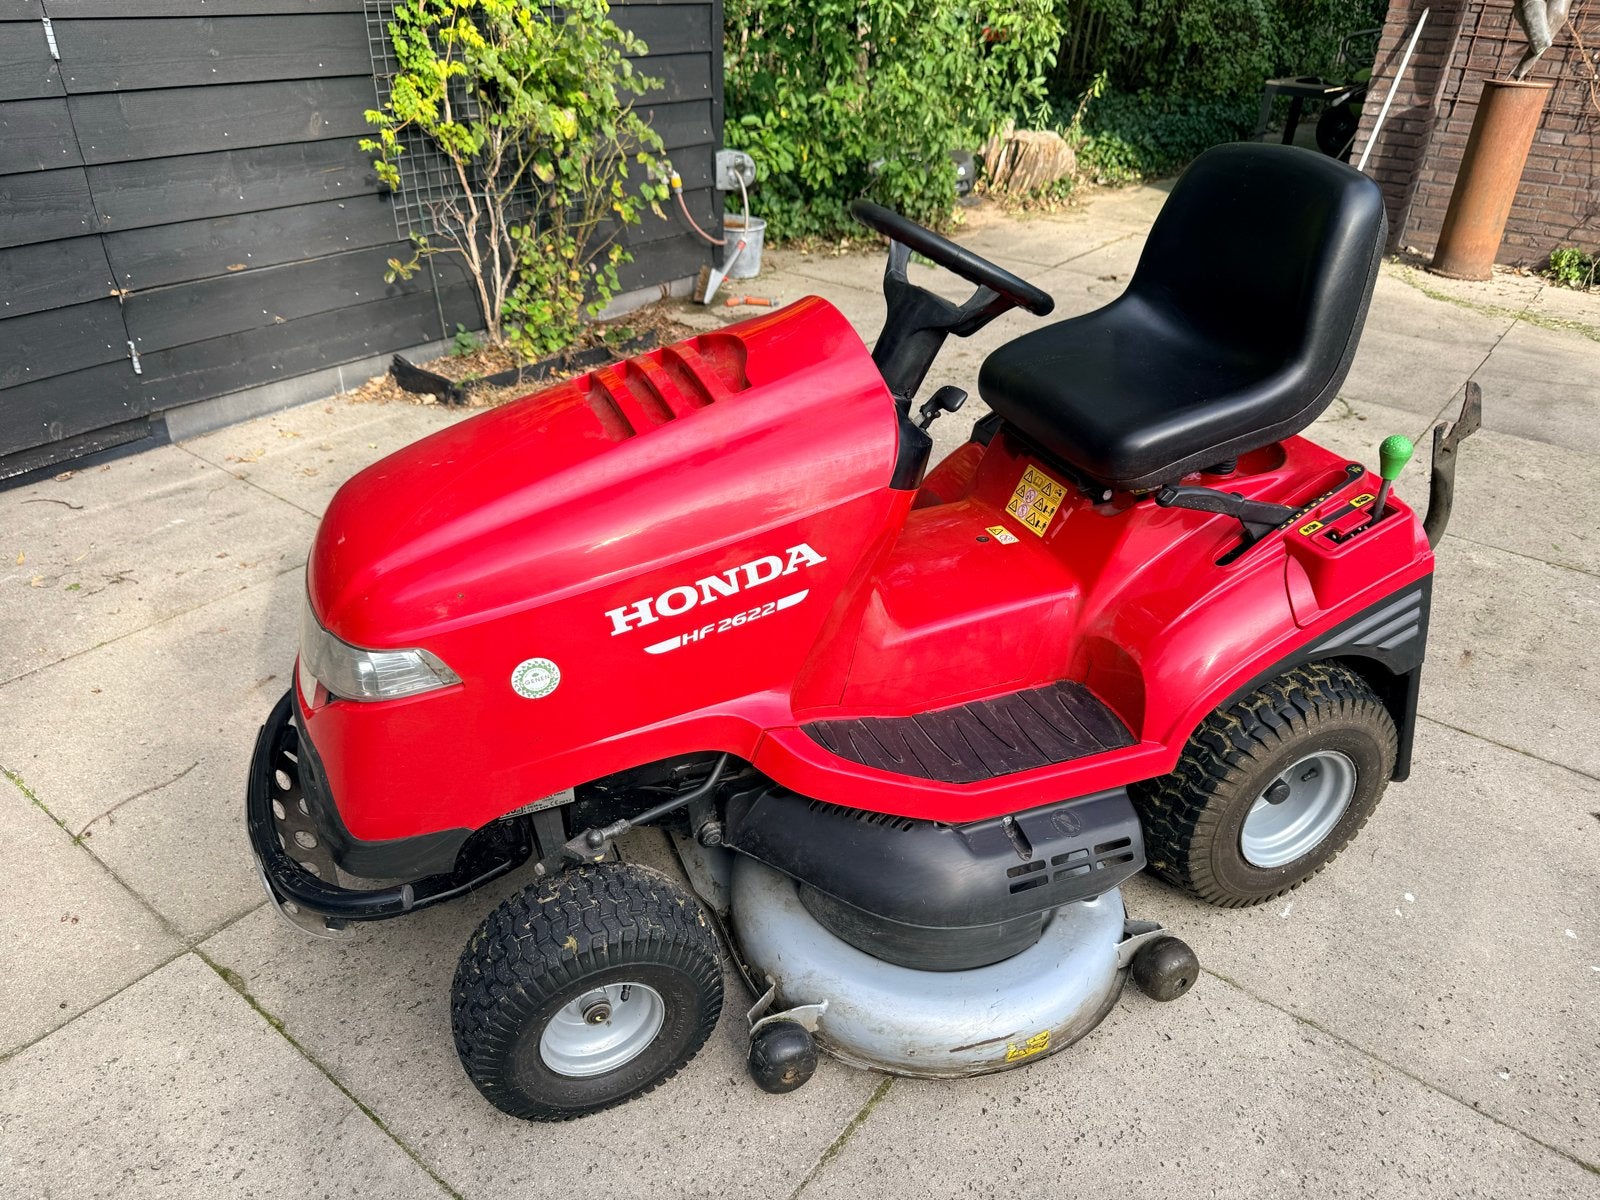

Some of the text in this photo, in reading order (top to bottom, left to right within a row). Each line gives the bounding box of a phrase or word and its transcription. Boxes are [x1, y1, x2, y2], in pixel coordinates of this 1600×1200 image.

[604, 542, 827, 637] HONDA
[682, 602, 776, 646] HF 2622
